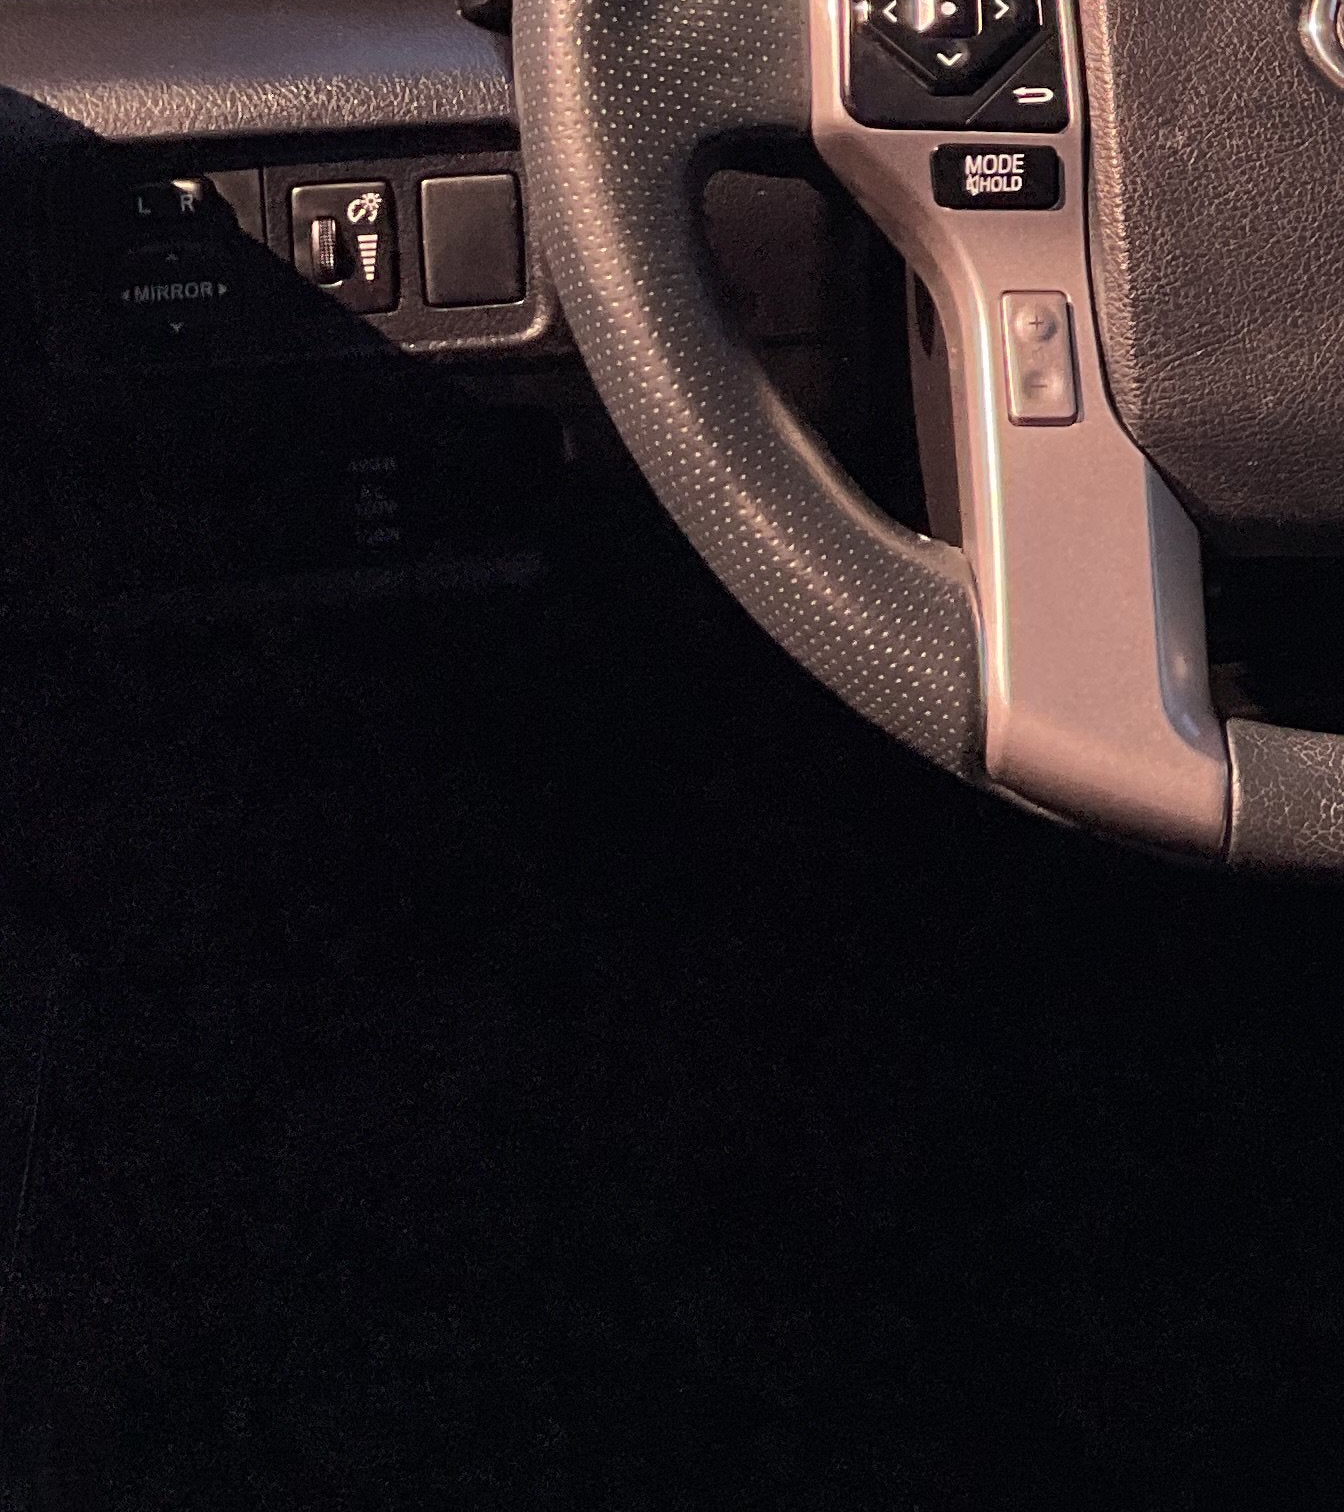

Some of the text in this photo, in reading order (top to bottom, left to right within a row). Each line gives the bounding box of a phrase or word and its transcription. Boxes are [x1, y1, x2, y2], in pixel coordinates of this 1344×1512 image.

[965, 154, 1024, 175] MODE
[979, 175, 1023, 192] HOLD
[180, 193, 196, 213] R
[133, 281, 214, 303] MIRROR
